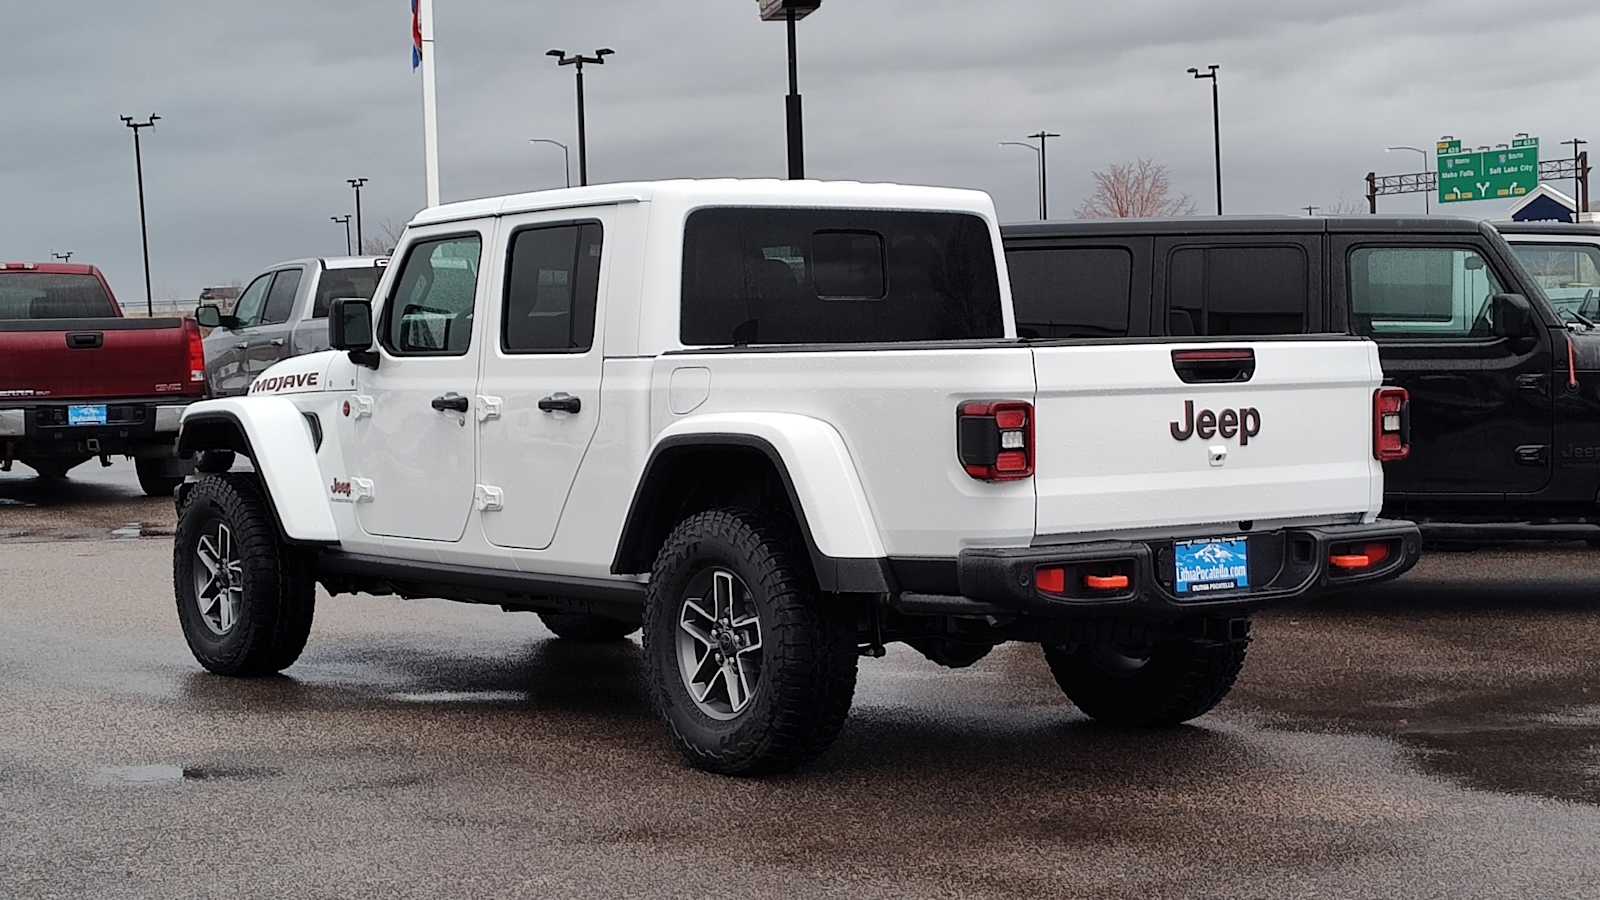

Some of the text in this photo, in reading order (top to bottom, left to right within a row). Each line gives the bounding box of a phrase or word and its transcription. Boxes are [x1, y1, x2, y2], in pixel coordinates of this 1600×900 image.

[252, 372, 319, 393] MOJAVE
[1170, 400, 1261, 446] Jeep
[330, 477, 352, 497] Jeep
[1176, 564, 1247, 583] LithiaPocatello.com
